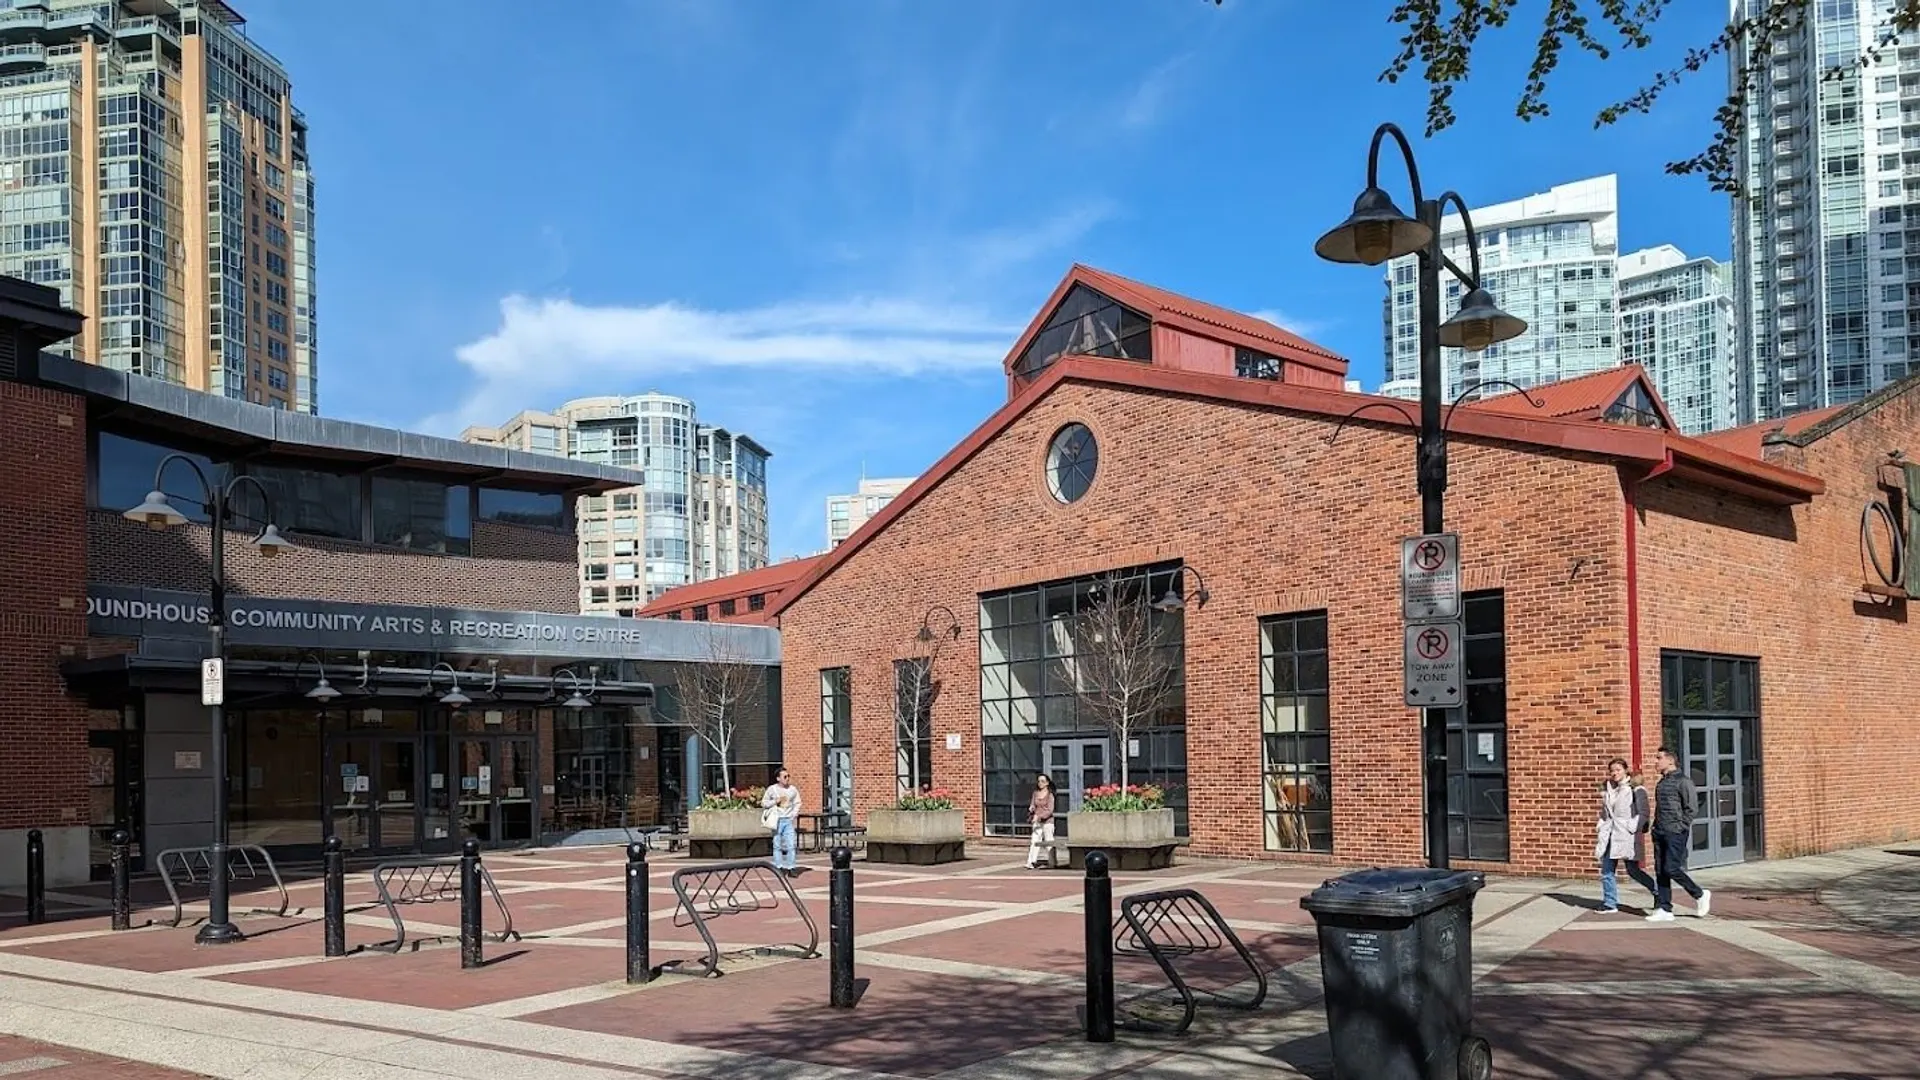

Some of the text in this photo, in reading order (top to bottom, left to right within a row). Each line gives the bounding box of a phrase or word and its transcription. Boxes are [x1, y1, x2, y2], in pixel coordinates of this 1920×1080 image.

[86, 597, 641, 644] UNDHOUS COMMUNITY ARTS & RECREATION CENTRE
[1432, 662, 1455, 670] AWAY
[1416, 673, 1447, 682] ZONE
